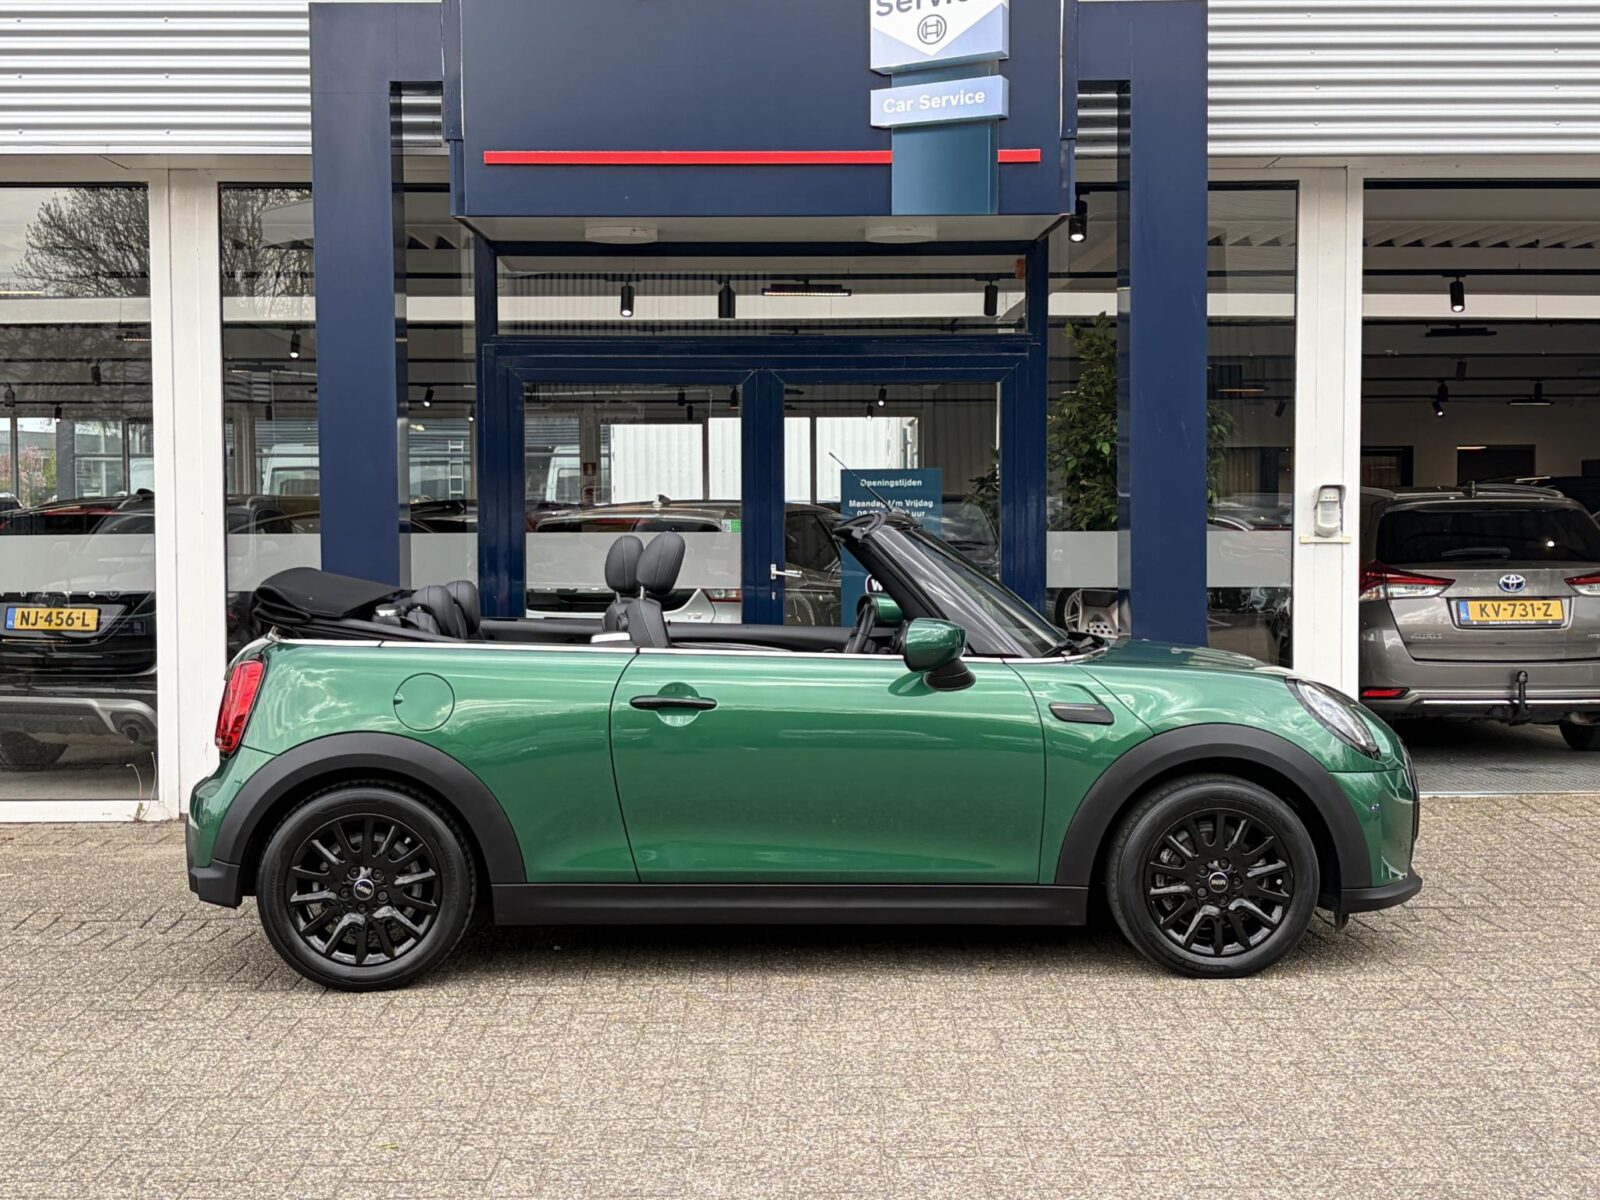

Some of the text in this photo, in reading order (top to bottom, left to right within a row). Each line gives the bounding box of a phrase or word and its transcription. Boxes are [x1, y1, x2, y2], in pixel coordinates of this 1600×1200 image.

[883, 90, 986, 113] Car Service
[860, 479, 922, 487] Openingstijden
[905, 500, 934, 508] Vrijdag
[1479, 603, 1553, 618] KV-731-Z
[19, 611, 90, 627] NJ-456-L
